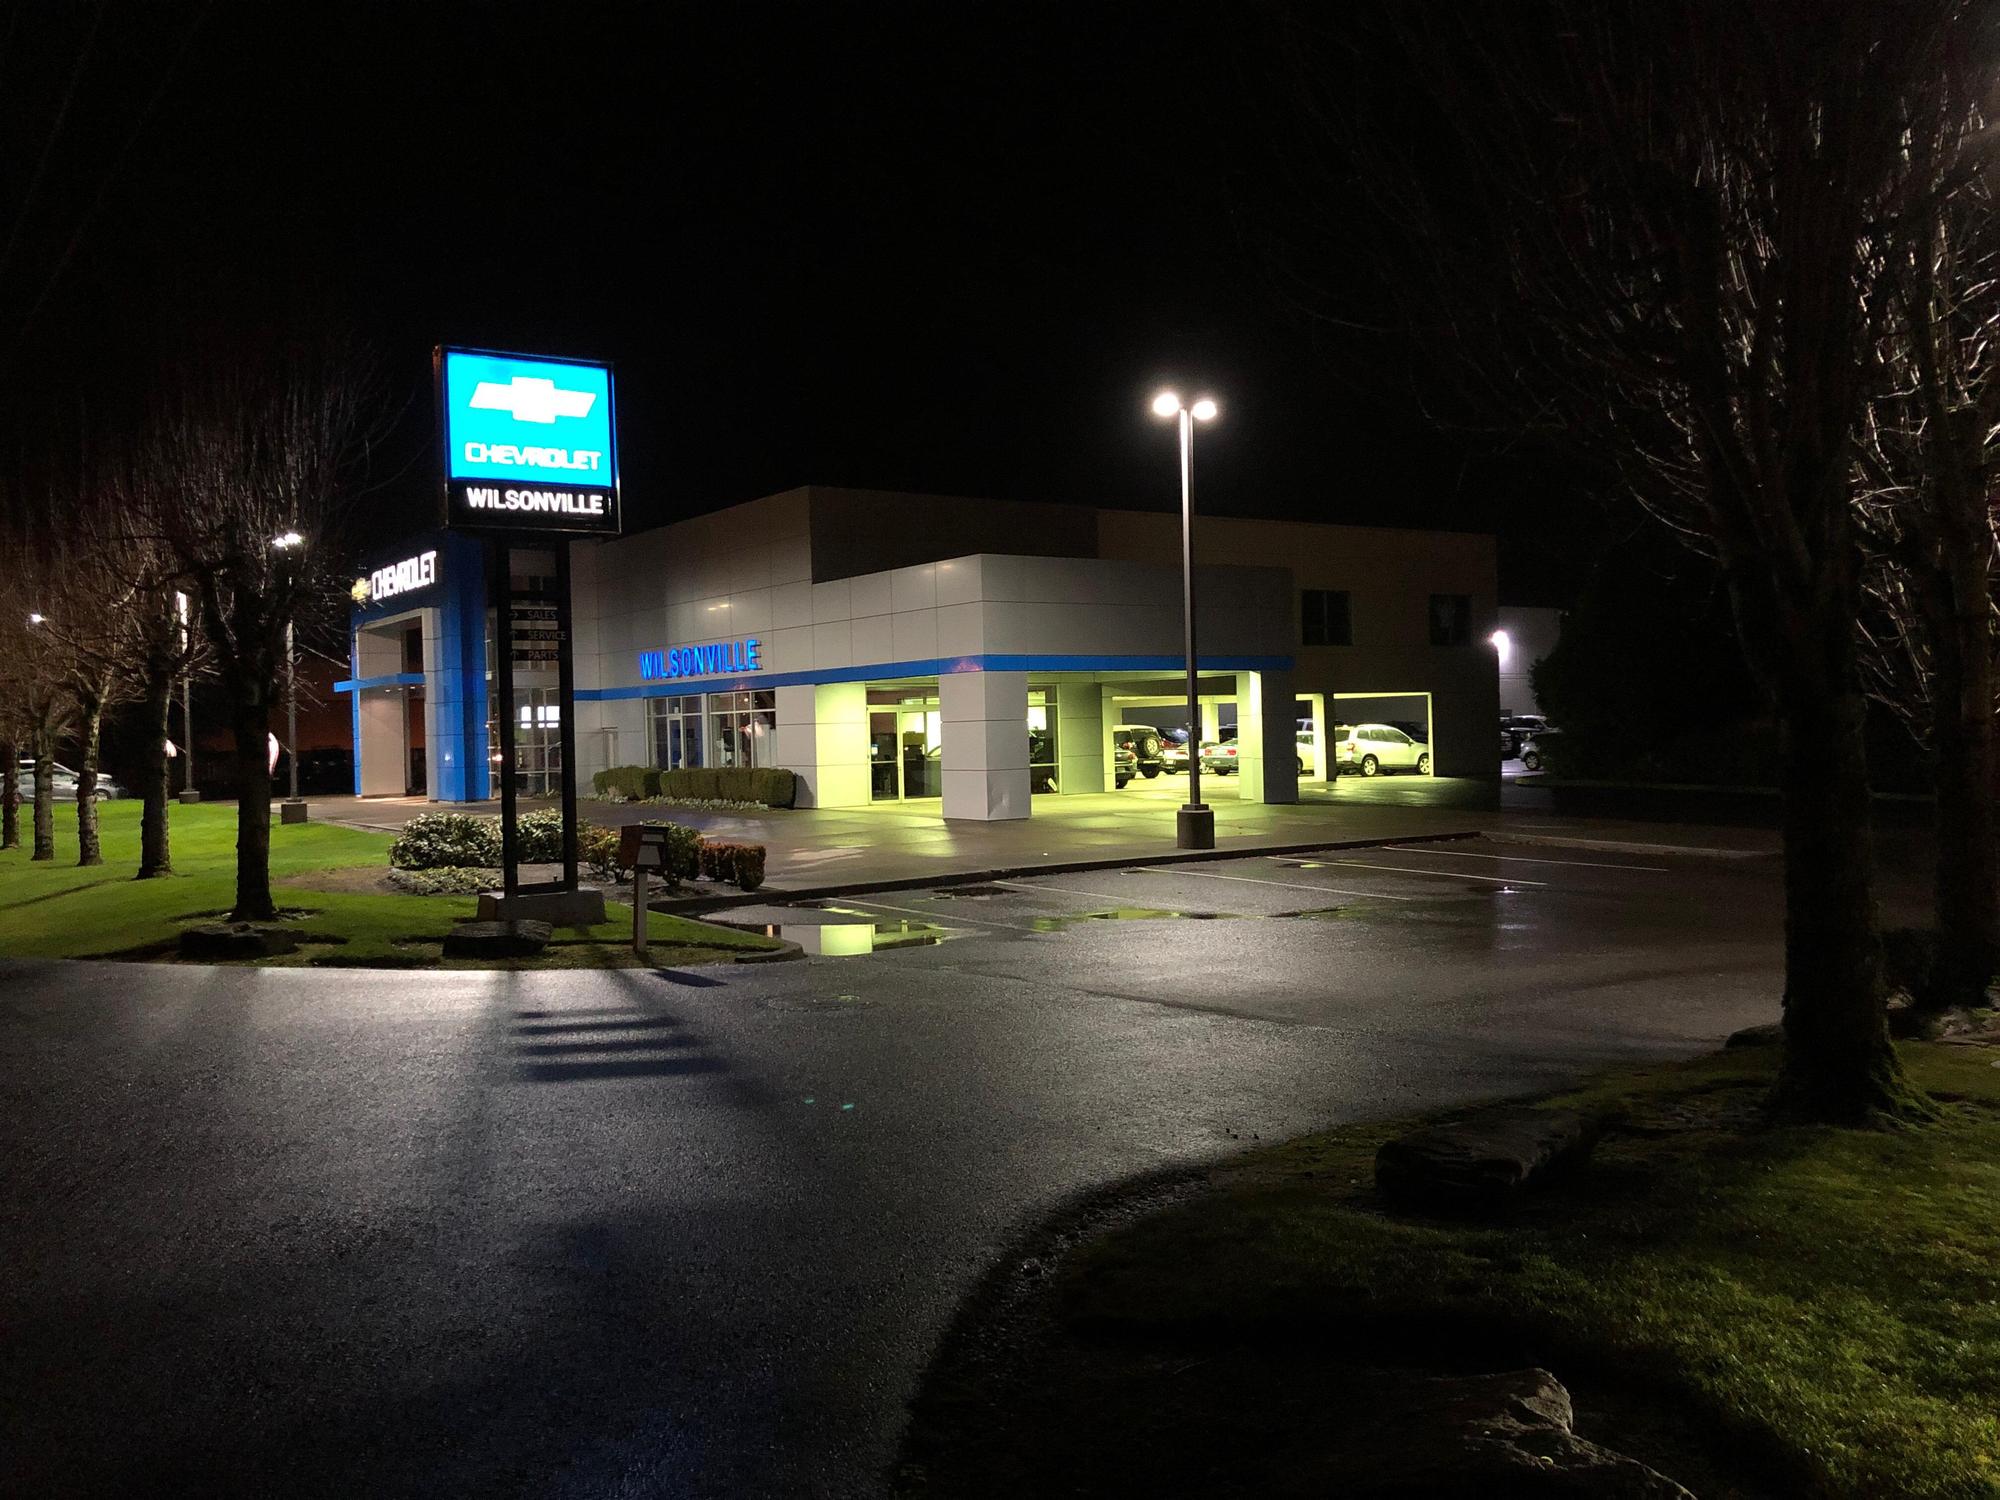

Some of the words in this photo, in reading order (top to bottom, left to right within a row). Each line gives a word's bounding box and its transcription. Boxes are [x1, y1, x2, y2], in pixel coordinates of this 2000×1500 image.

[464, 441, 602, 470] CHEVROLET
[466, 487, 604, 514] WILSONVILLE
[371, 550, 437, 601] CHEVROLET
[527, 610, 556, 620] SALES
[527, 631, 567, 640] SERVICE
[527, 651, 559, 660] PARTS
[640, 639, 761, 680] WILSONVILLE
